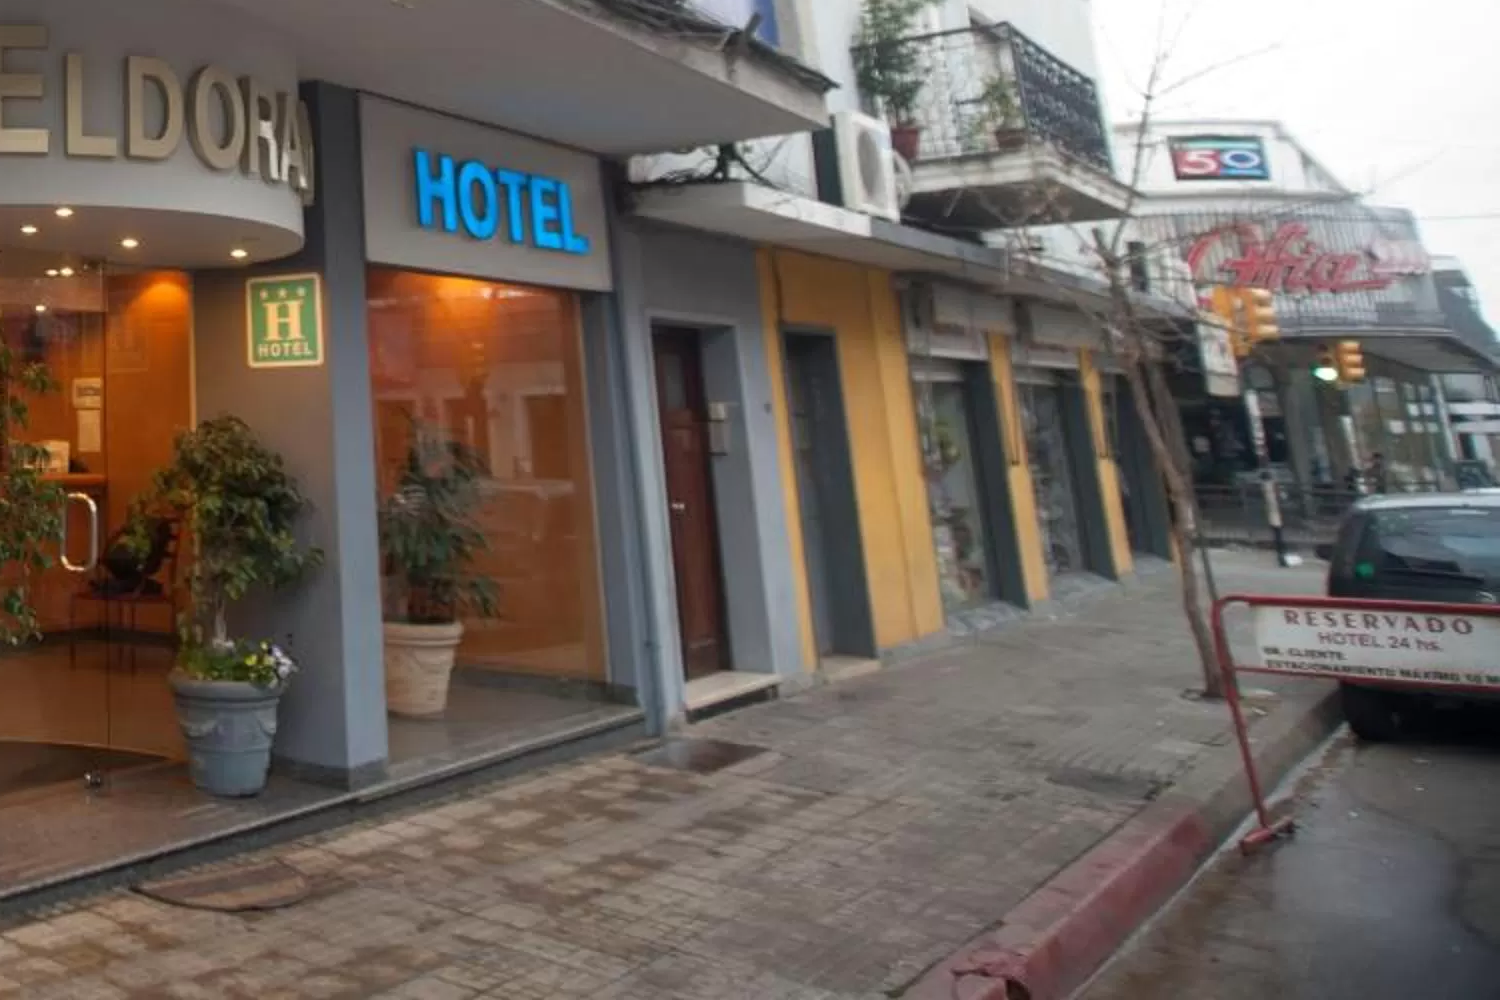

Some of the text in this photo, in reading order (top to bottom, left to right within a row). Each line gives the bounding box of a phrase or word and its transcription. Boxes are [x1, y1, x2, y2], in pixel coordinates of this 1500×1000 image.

[414, 148, 591, 254] HOTEL
[262, 300, 306, 341] H
[257, 341, 315, 357] HOTEL
[1283, 609, 1474, 635] RESERVADO
[1318, 631, 1382, 648] HOTEL
[1388, 635, 1411, 649] 24
